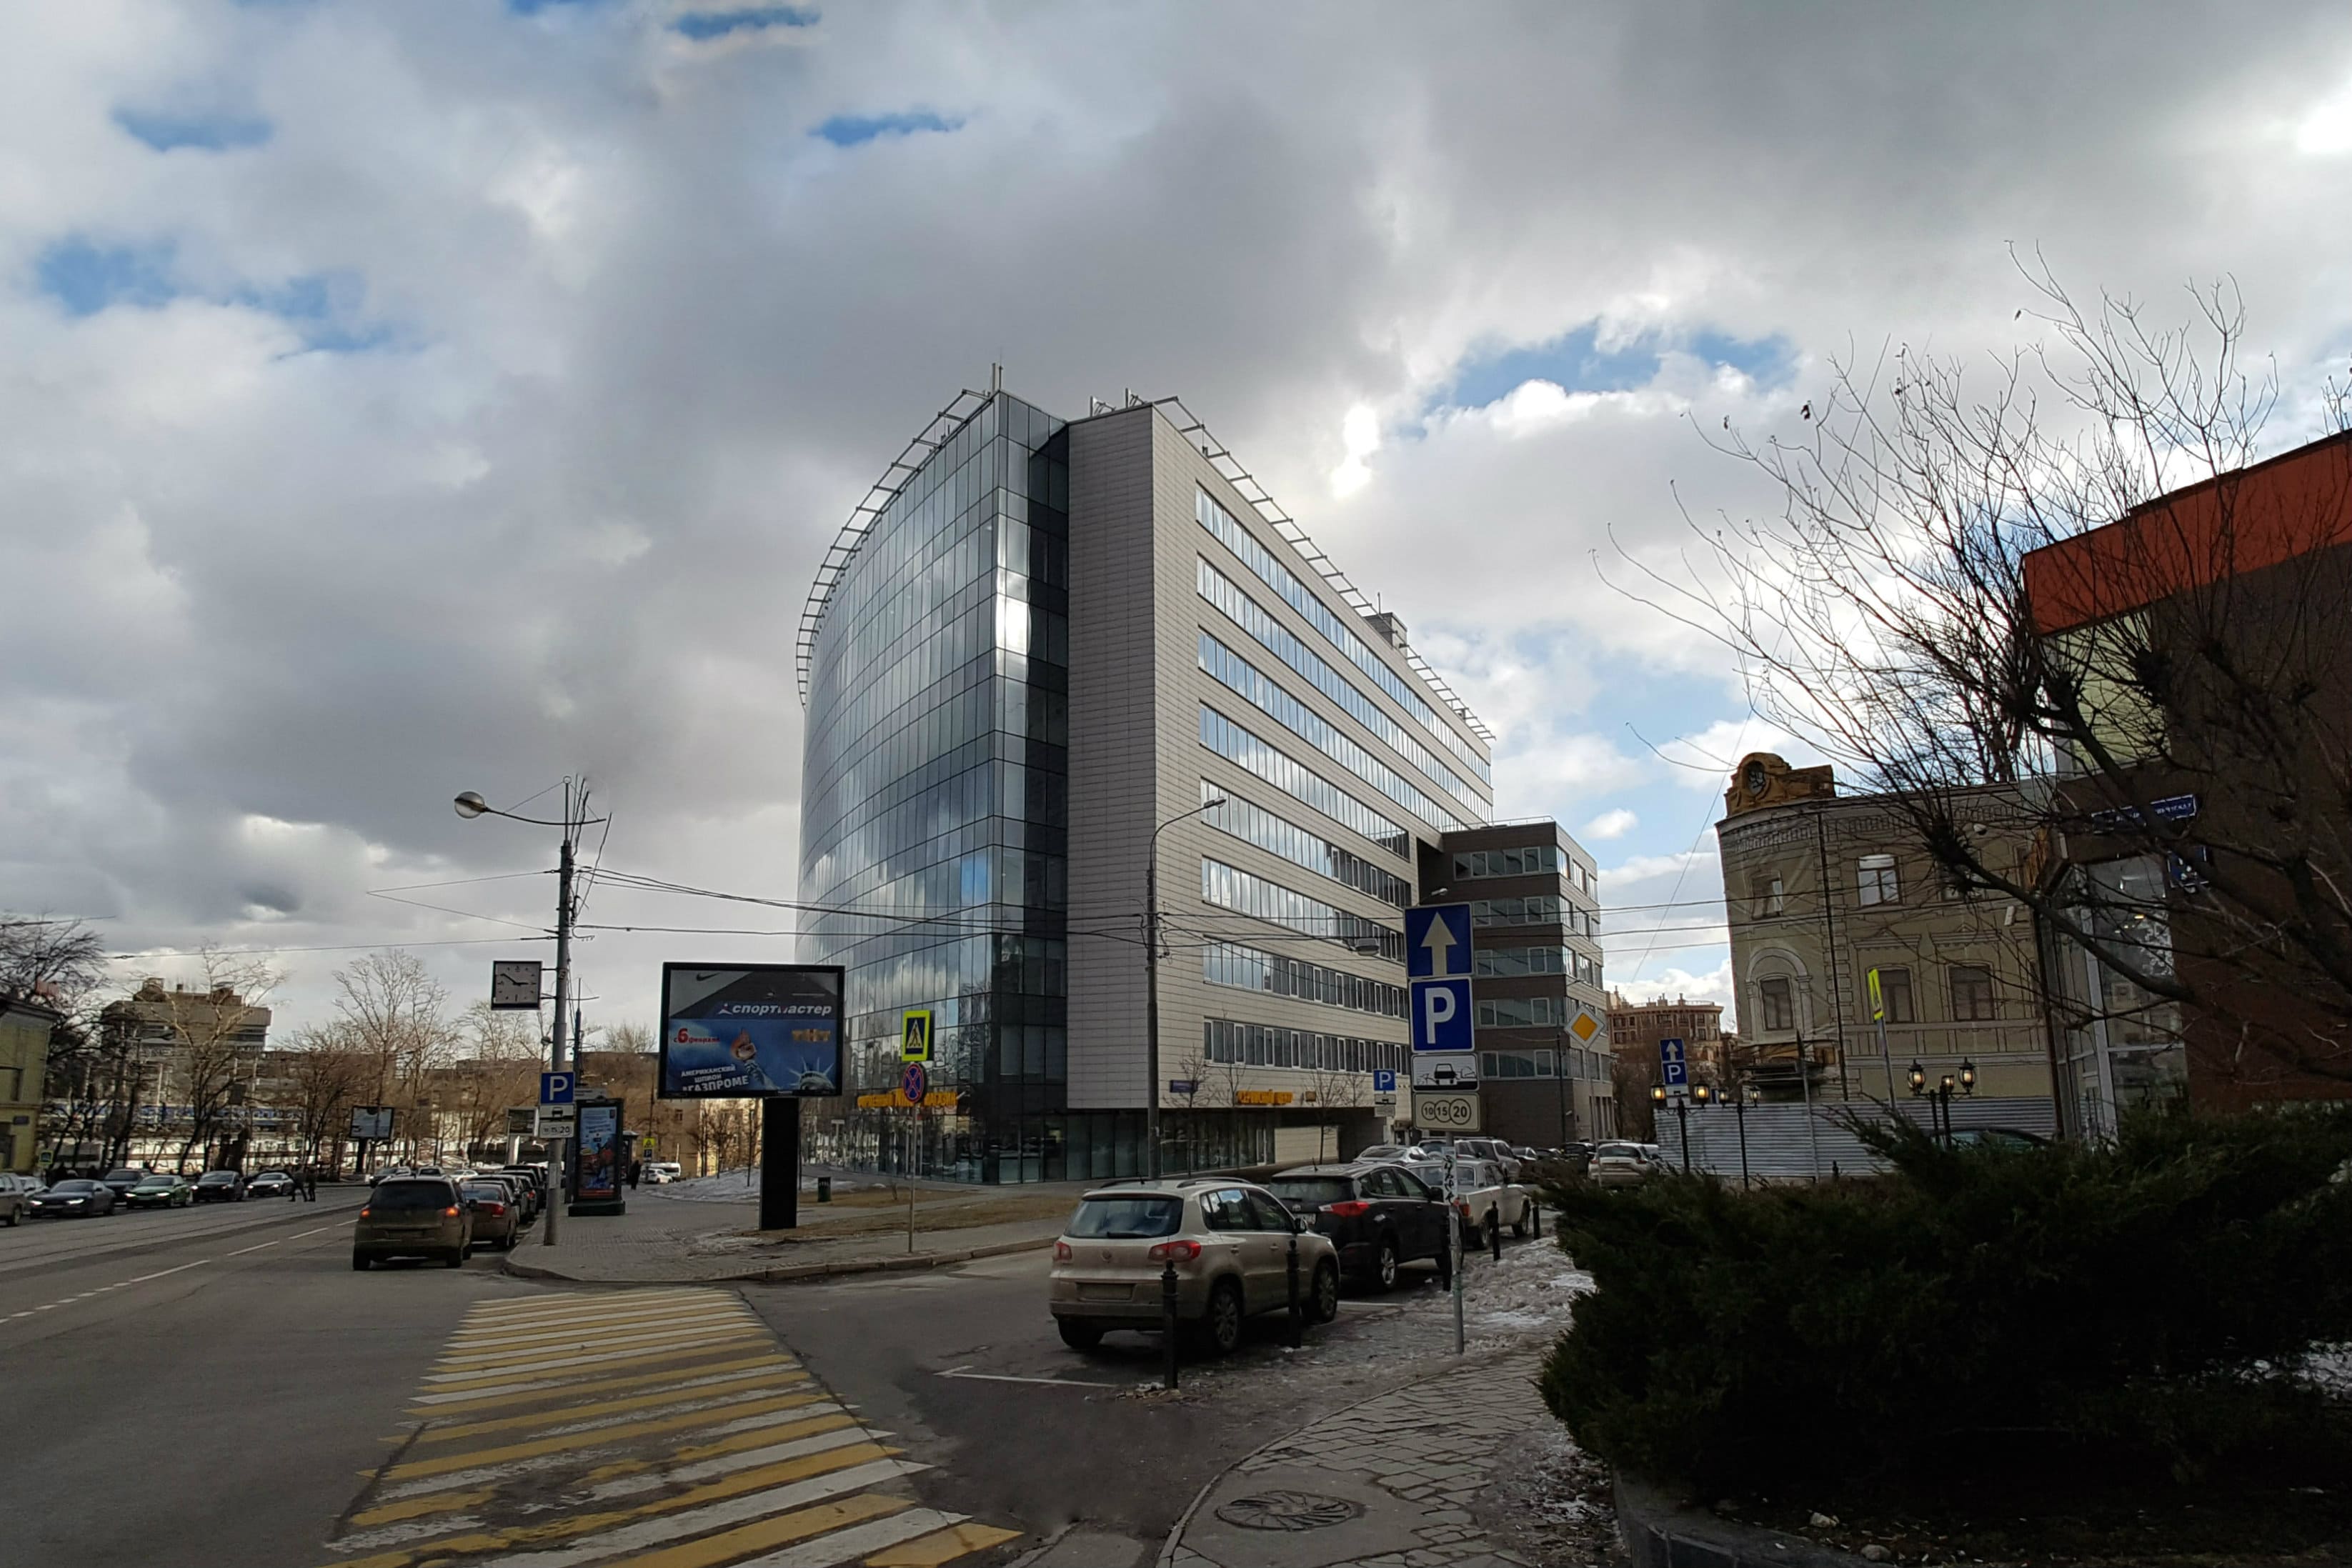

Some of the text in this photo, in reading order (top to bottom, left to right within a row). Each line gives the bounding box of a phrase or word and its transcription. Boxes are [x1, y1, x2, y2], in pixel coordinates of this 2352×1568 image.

[1425, 987, 1456, 1044] P
[677, 1028, 688, 1043] 6
[681, 1064, 737, 1077] АМЕРИКАНСКИЙ
[694, 1074, 722, 1083] ШПИОН
[1668, 1064, 1681, 1083] P
[549, 1075, 568, 1101] P
[688, 1075, 749, 1092] ГАЗПРОМЕ
[1380, 1072, 1392, 1089] P
[1437, 1107, 1447, 1116] 15
[1453, 1107, 1467, 1118] 20
